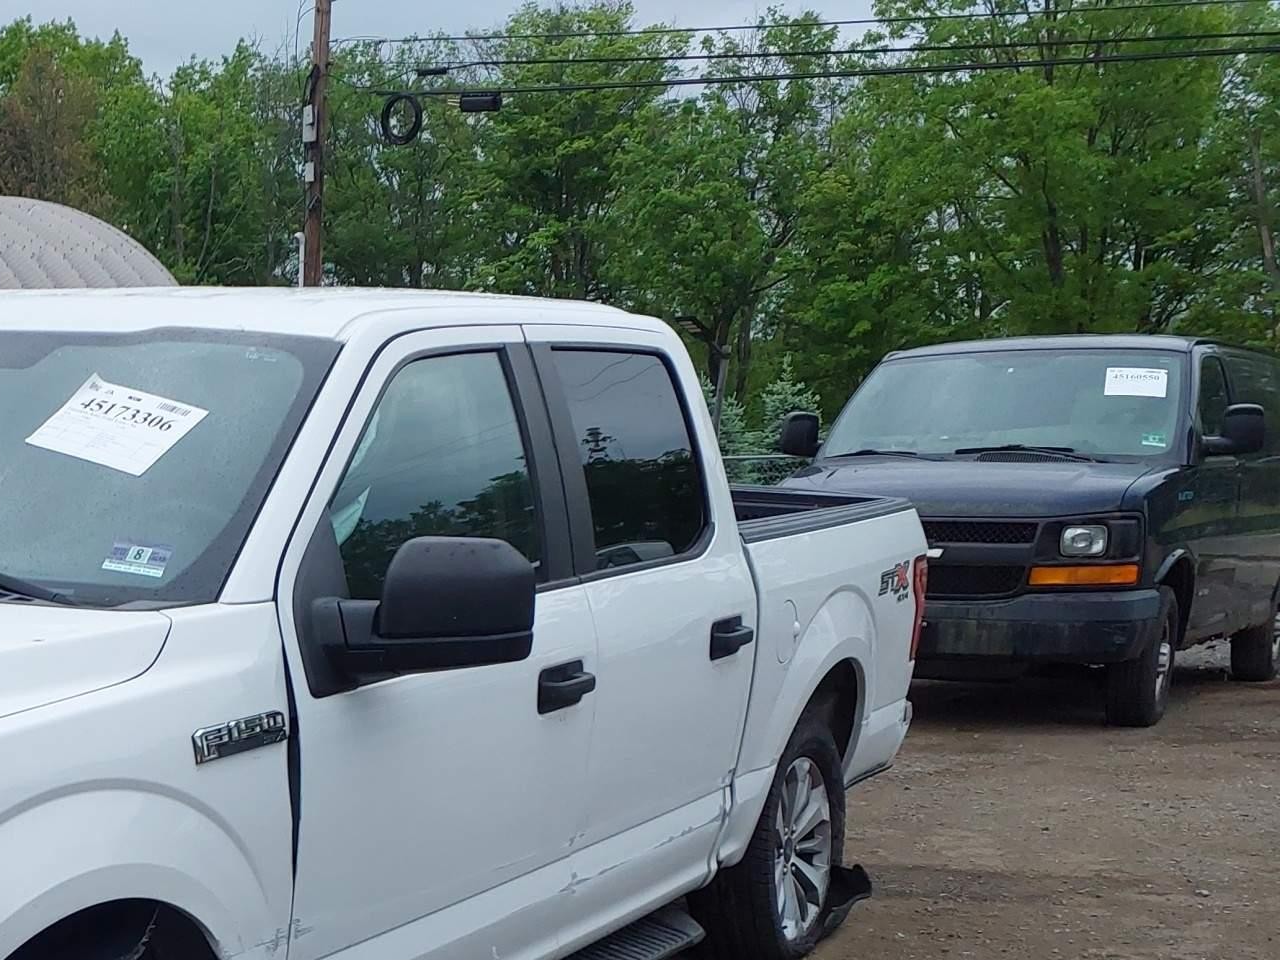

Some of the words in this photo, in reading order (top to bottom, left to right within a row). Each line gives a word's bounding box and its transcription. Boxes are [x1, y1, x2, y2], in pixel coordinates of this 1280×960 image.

[80, 397, 176, 431] 45173306
[133, 548, 145, 560] 8
[878, 560, 910, 597] STX
